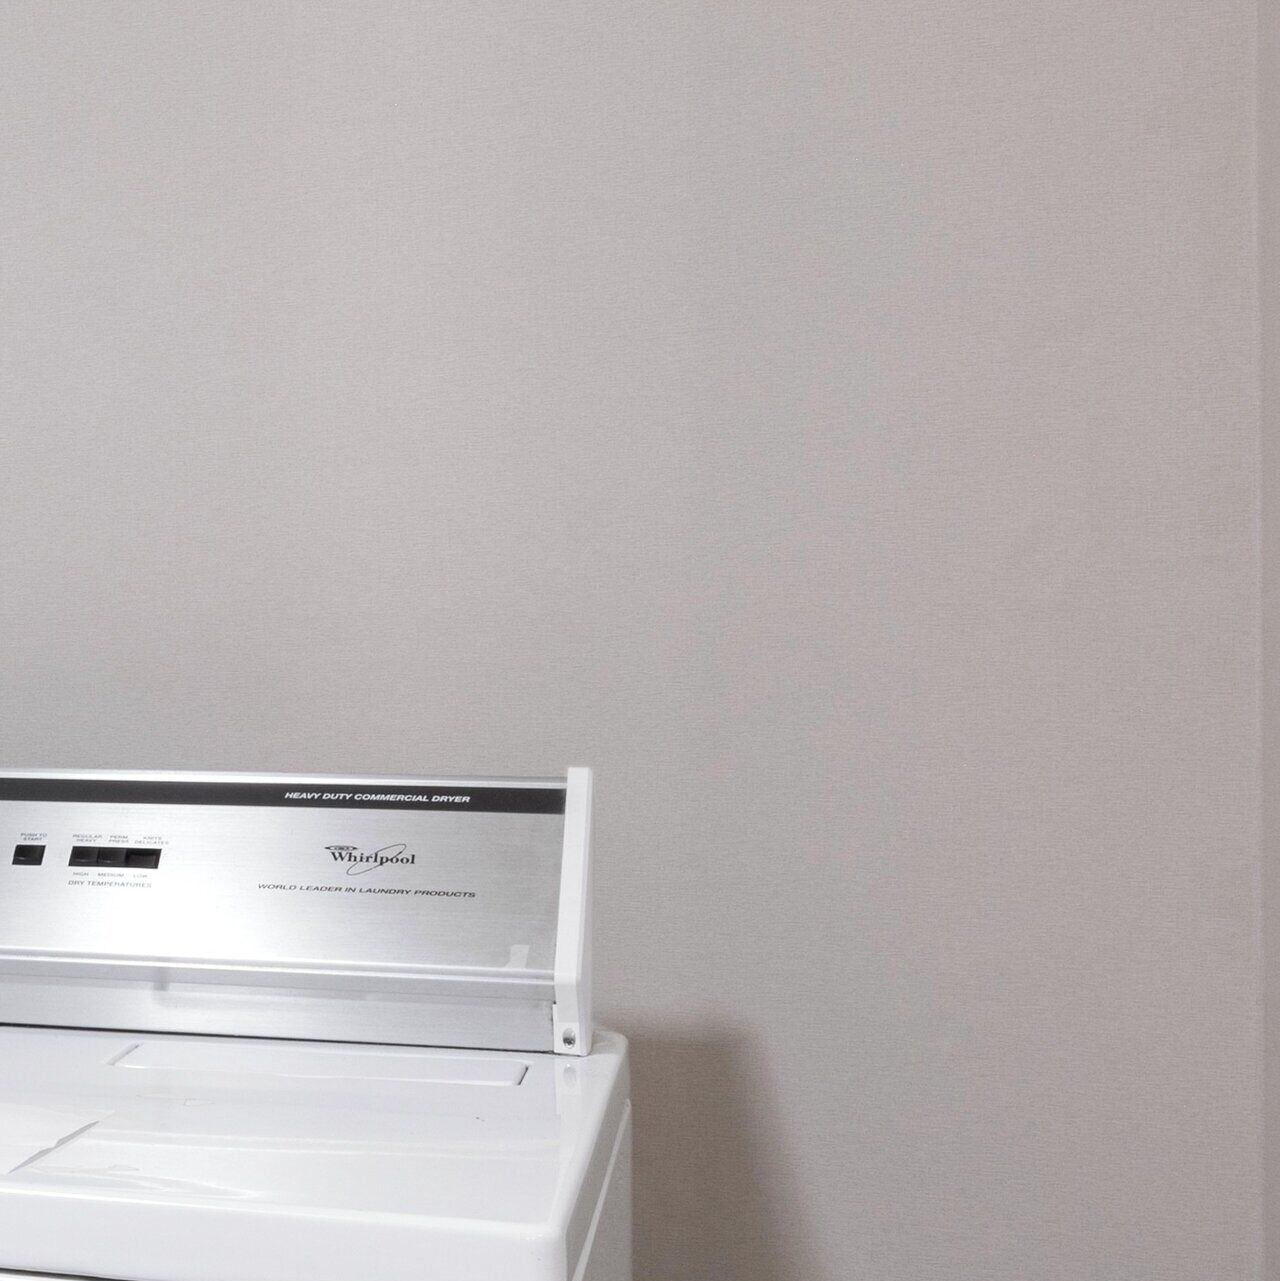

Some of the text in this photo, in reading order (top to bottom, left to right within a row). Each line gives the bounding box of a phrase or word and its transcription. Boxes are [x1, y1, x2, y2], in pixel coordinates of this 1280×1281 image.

[284, 791, 471, 803] HEAVY DUTY COMMERCIAL DRYER
[330, 851, 415, 867] Whirlpool
[87, 881, 152, 889] TEMPERATURES
[299, 885, 343, 893] LEADER
[359, 887, 412, 896] LAUNDRY
[413, 889, 477, 898] PRODUCTS
